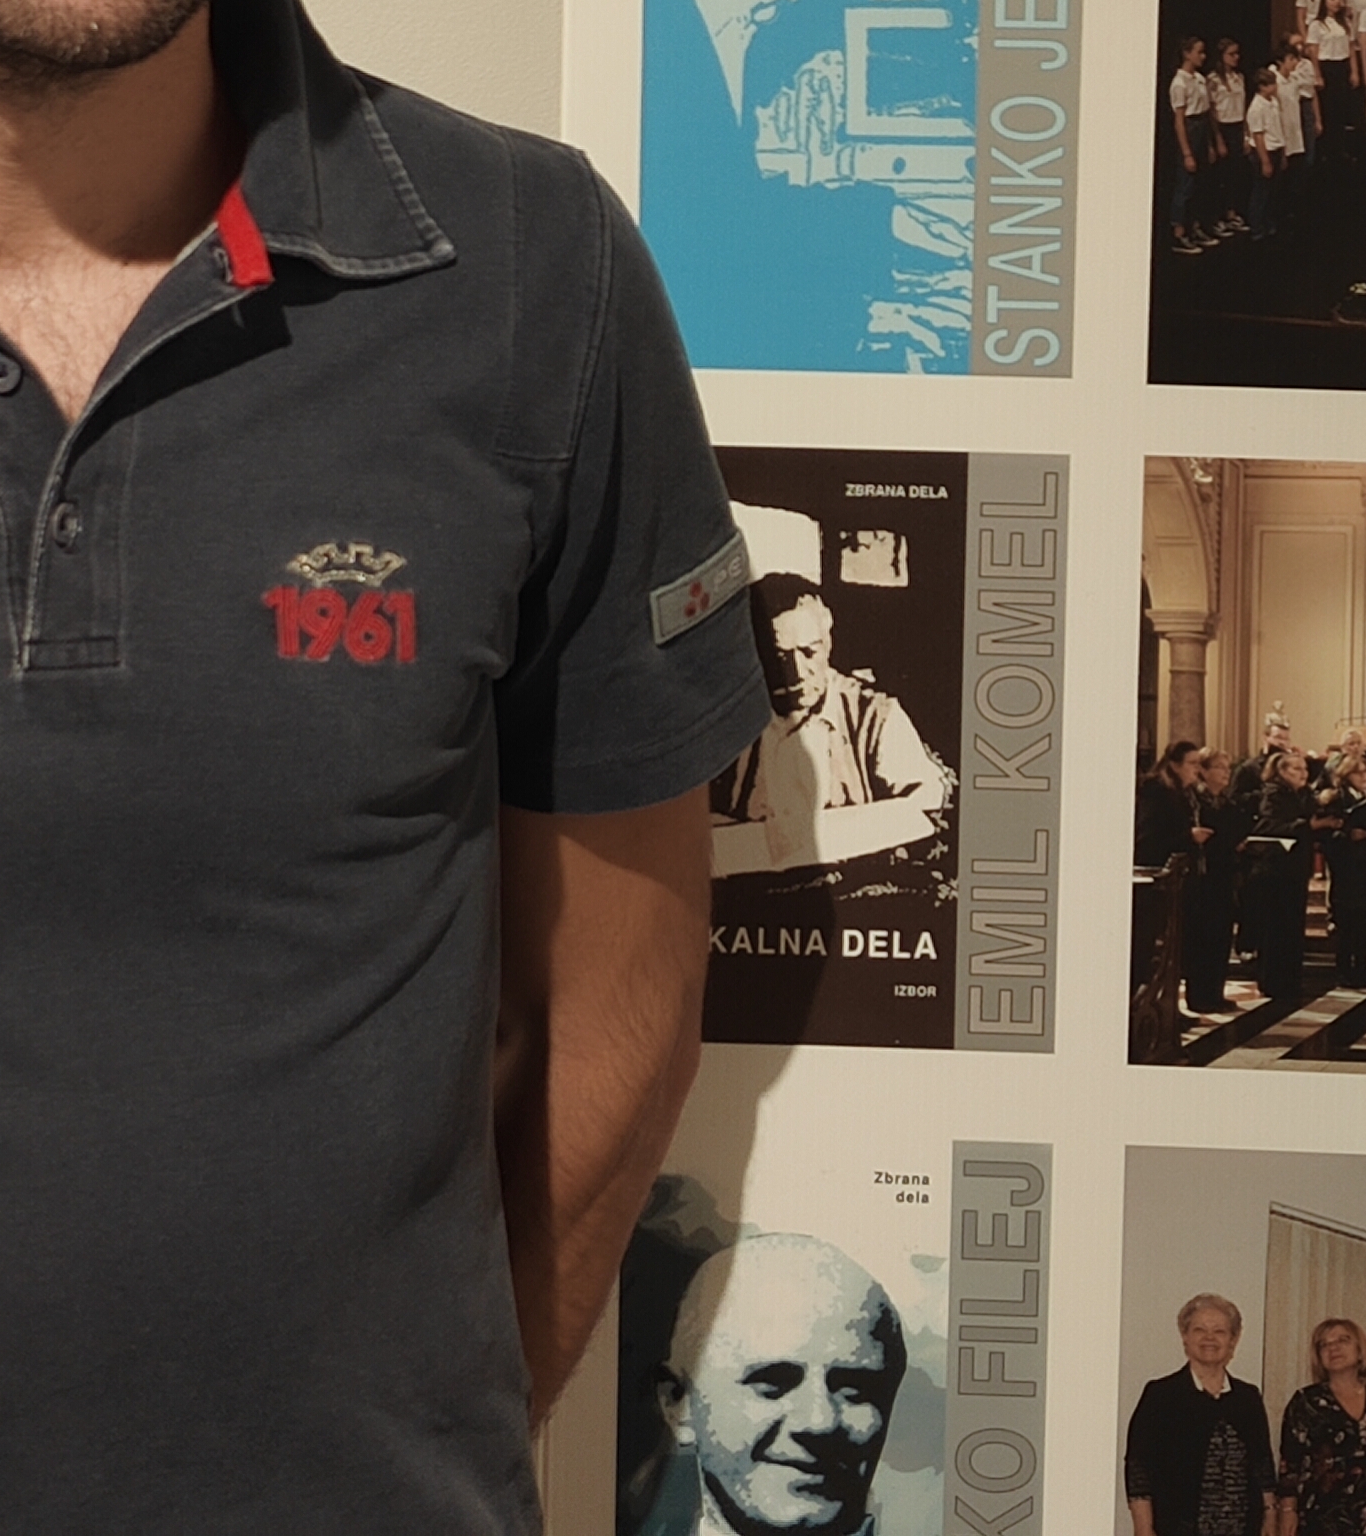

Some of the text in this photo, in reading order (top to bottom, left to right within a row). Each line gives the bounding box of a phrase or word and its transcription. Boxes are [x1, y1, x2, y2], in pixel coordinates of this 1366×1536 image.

[983, 95, 1067, 367] STANKO
[845, 483, 949, 499] ZBRANA DELA
[262, 585, 415, 664] 1961
[967, 471, 1059, 1037] EMIL KOMEL
[842, 930, 938, 960] DELA
[894, 984, 937, 998] IZBOR
[873, 1171, 931, 1186] Zbrana
[895, 1191, 931, 1205] dela
[957, 1160, 1045, 1398] FILEJ
